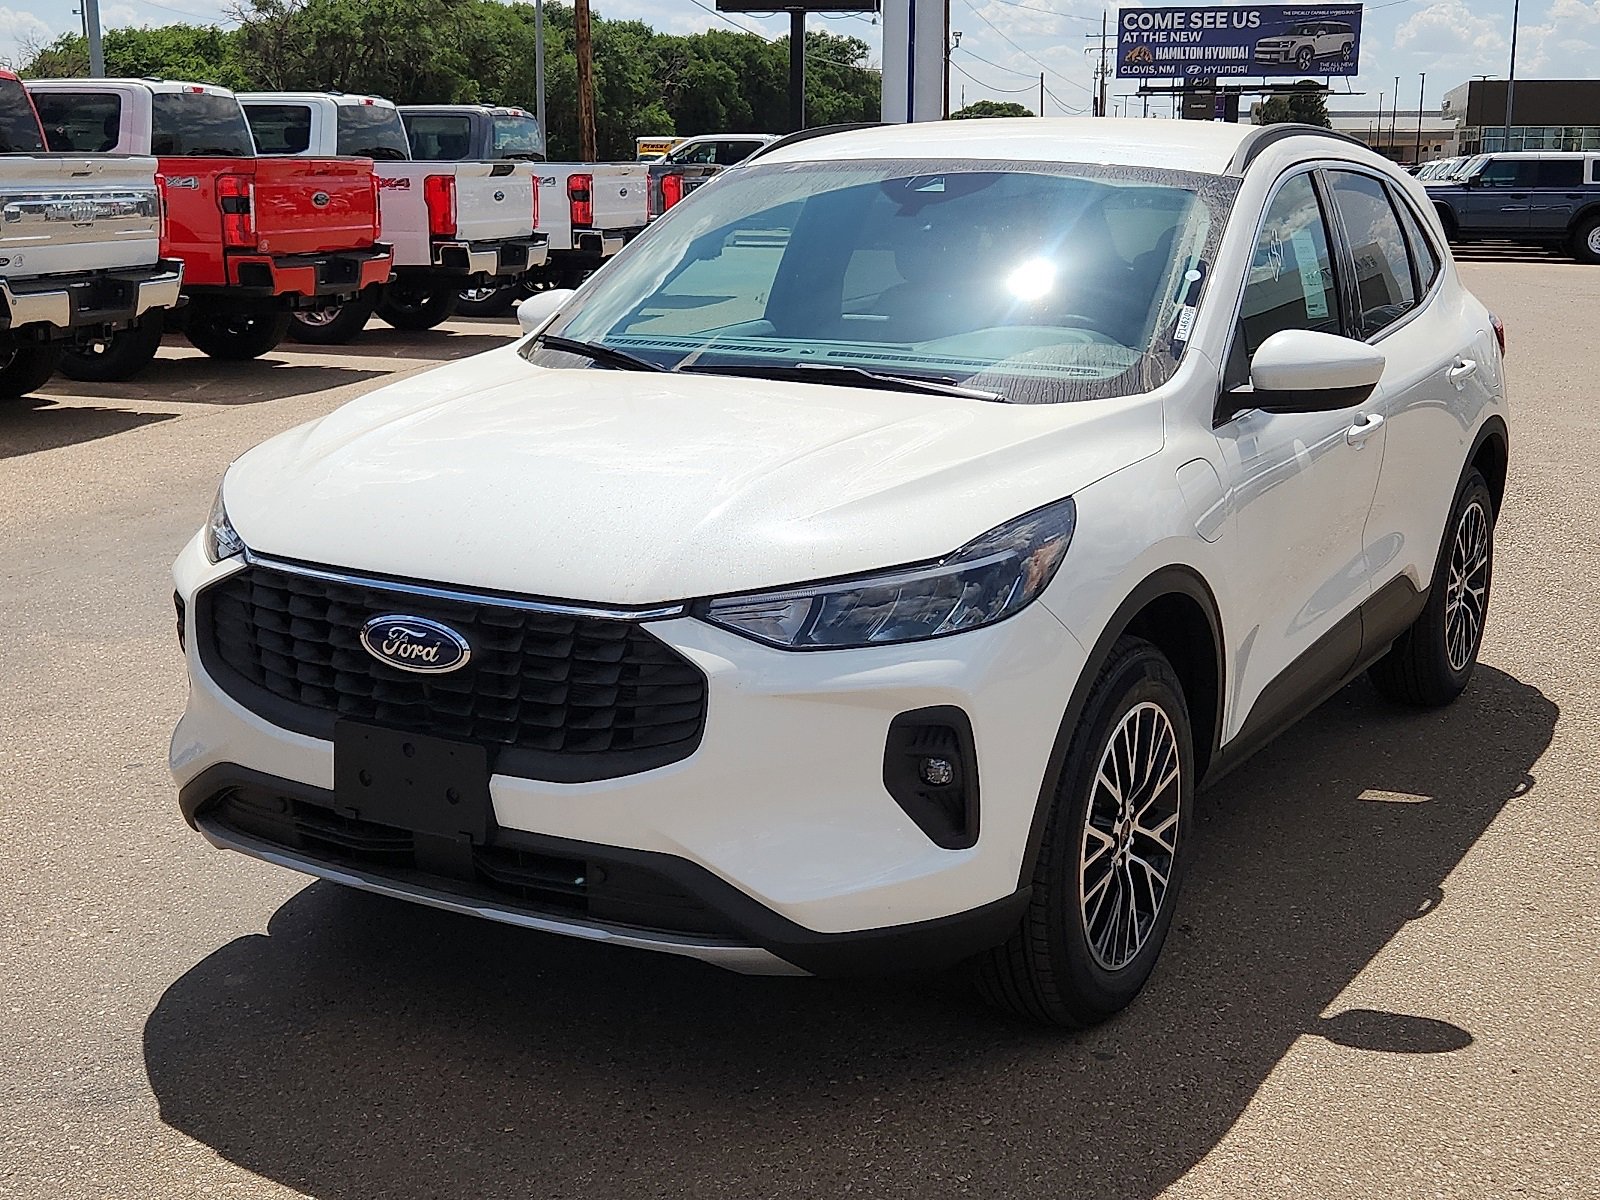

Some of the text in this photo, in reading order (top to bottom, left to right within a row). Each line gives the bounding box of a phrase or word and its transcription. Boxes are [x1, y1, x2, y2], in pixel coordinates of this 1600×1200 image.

[1123, 11, 1261, 30] COME SEE US
[1122, 31, 1203, 43] AT THE NEW
[1155, 46, 1249, 60] HAMILTON HYUNDAI
[1120, 65, 1175, 75] CLOVIS, NM
[1203, 65, 1248, 74] HYUNDAI
[382, 626, 440, 662] Ford
